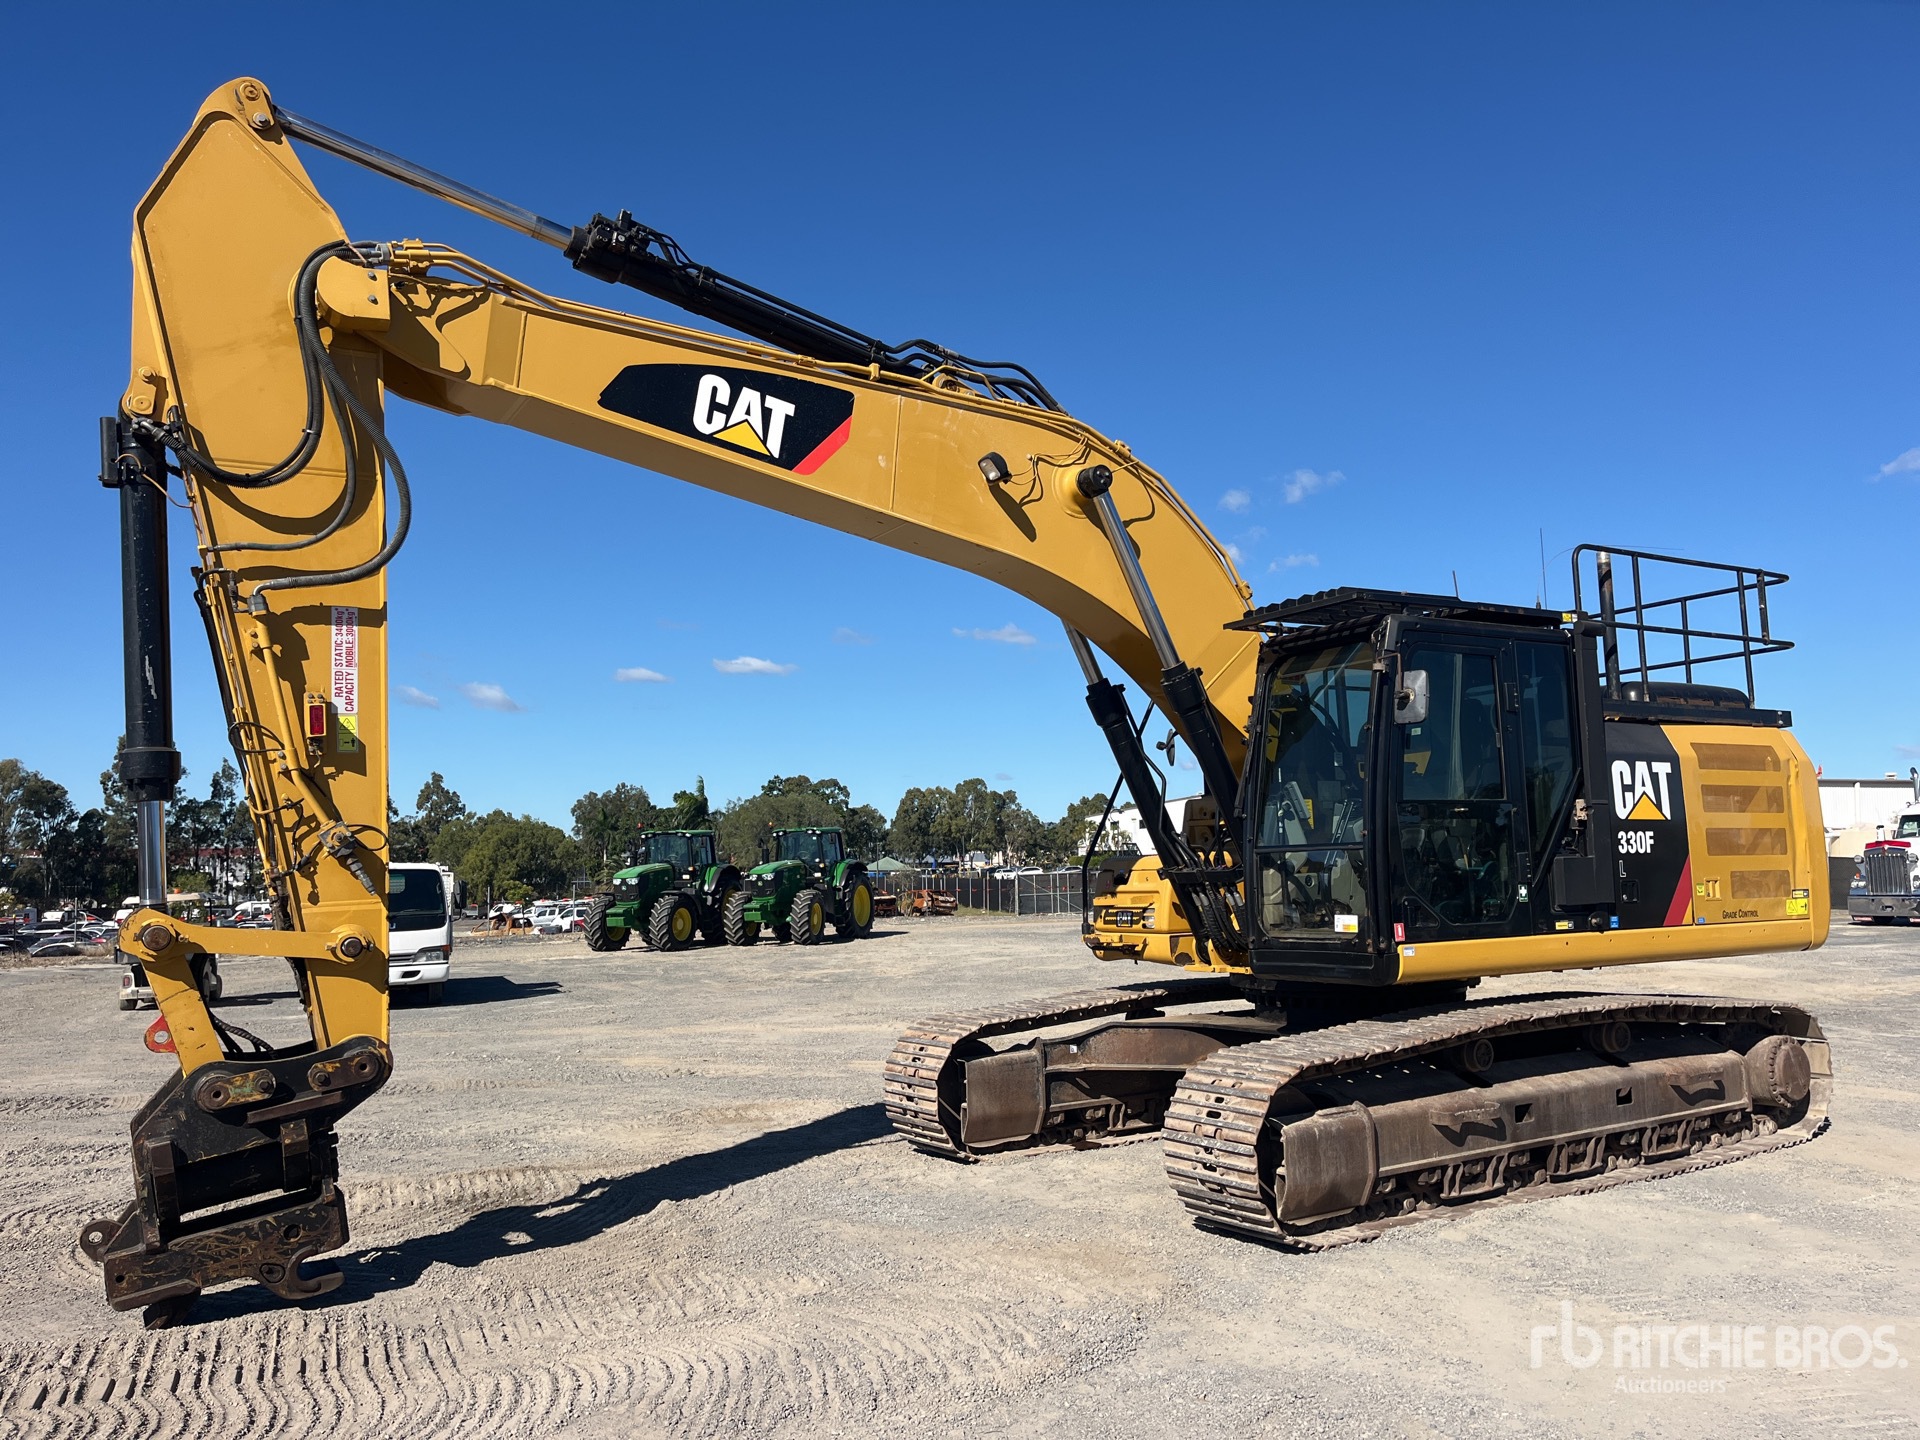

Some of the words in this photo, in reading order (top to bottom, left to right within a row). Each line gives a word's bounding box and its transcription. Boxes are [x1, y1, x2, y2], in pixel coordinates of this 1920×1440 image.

[692, 373, 796, 459] CAT
[334, 670, 344, 697] RATED
[345, 671, 354, 712] CAPACITY
[1611, 760, 1672, 820] CAT
[1617, 831, 1655, 854] 330F
[1618, 860, 1627, 878] L
[1117, 911, 1132, 927] CAT
